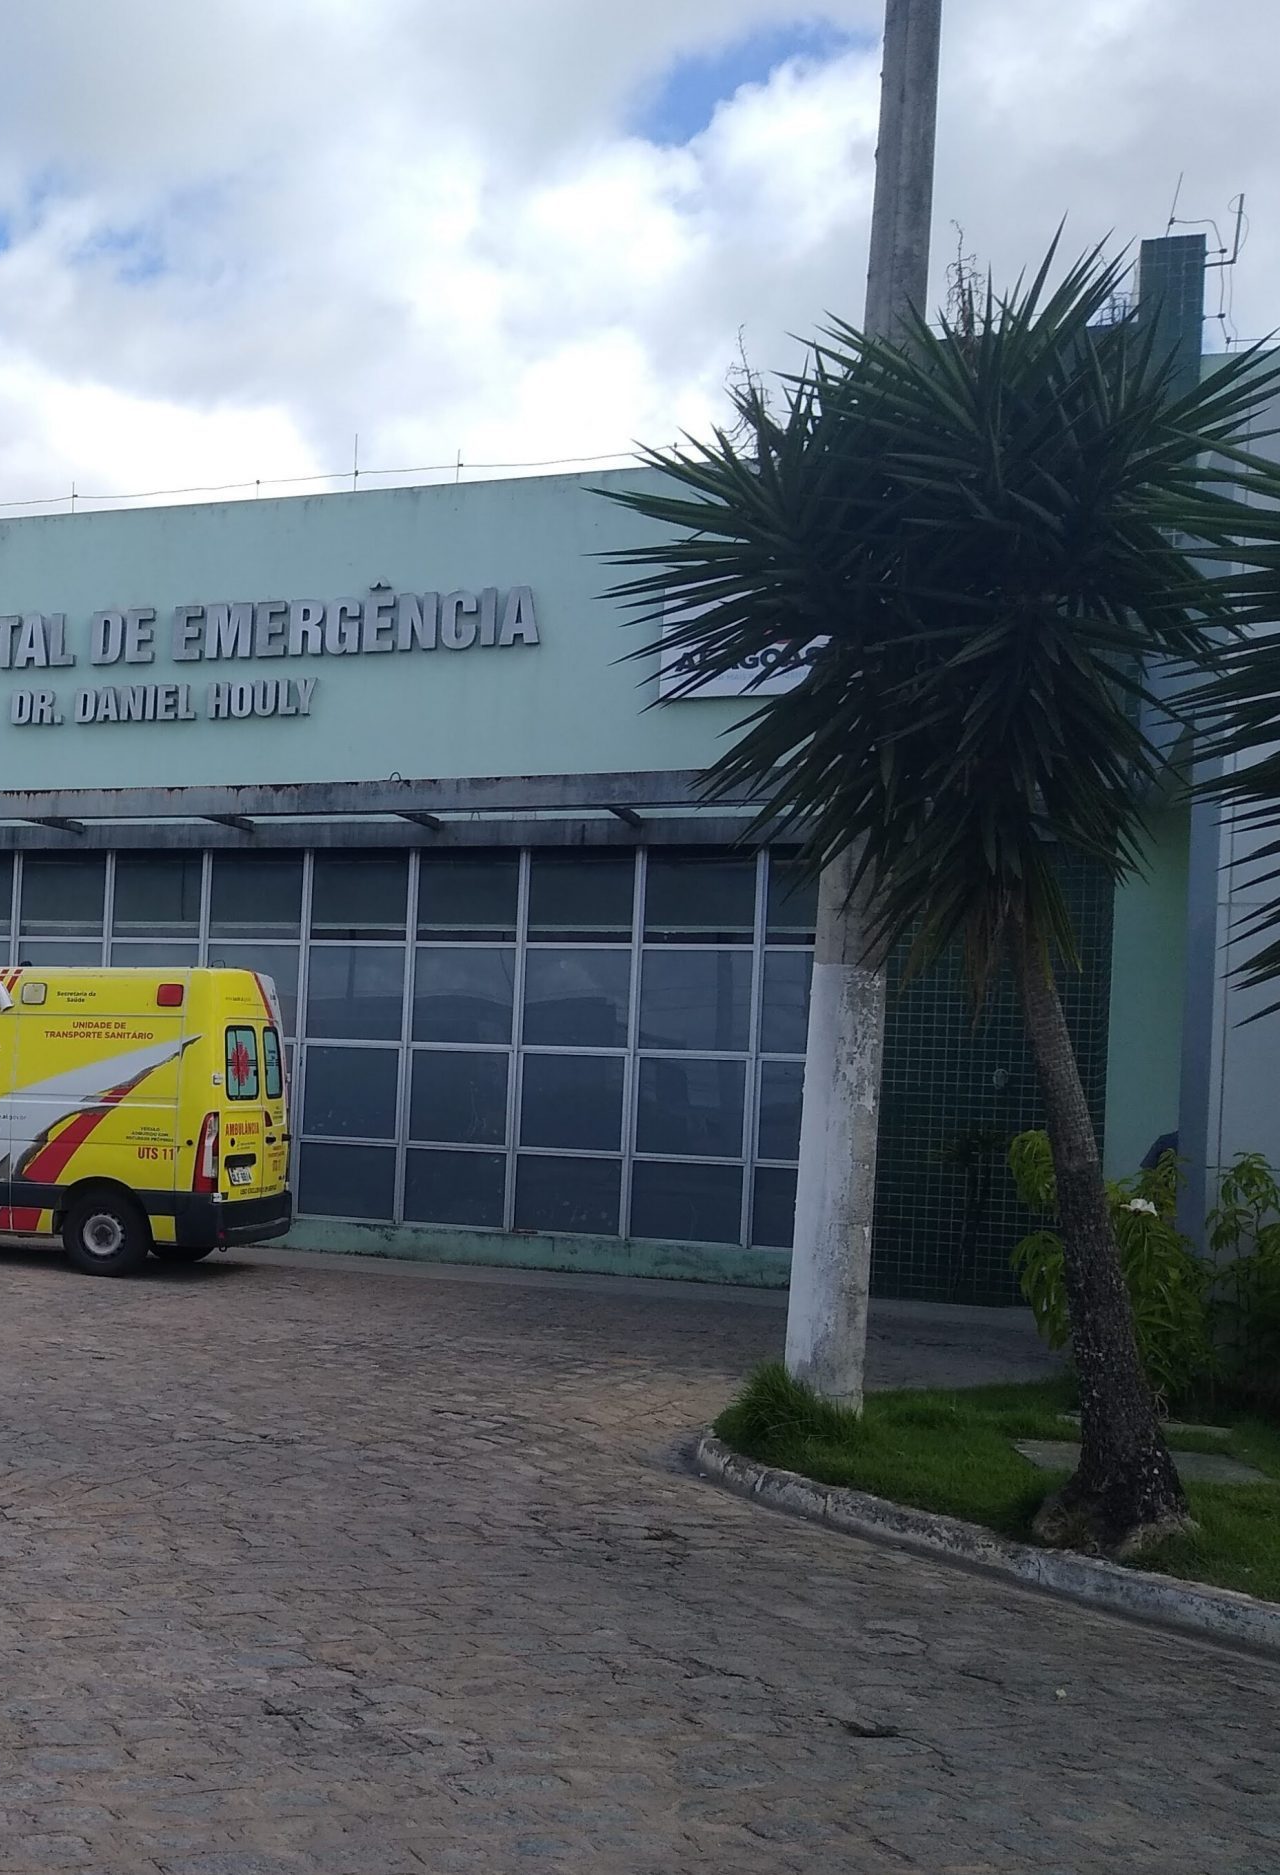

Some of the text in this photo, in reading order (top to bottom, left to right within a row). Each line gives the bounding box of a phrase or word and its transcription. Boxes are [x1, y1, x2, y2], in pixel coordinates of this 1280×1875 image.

[90, 607, 156, 665] DE
[172, 576, 540, 662] EMERGÊNCIA
[11, 677, 318, 725] DR. DANIEL HOULY
[72, 1021, 127, 1030] UNIDADE DE
[45, 1030, 154, 1040] TRANSPORTE SANITÁRIO
[137, 1146, 174, 1160] UTS 11
